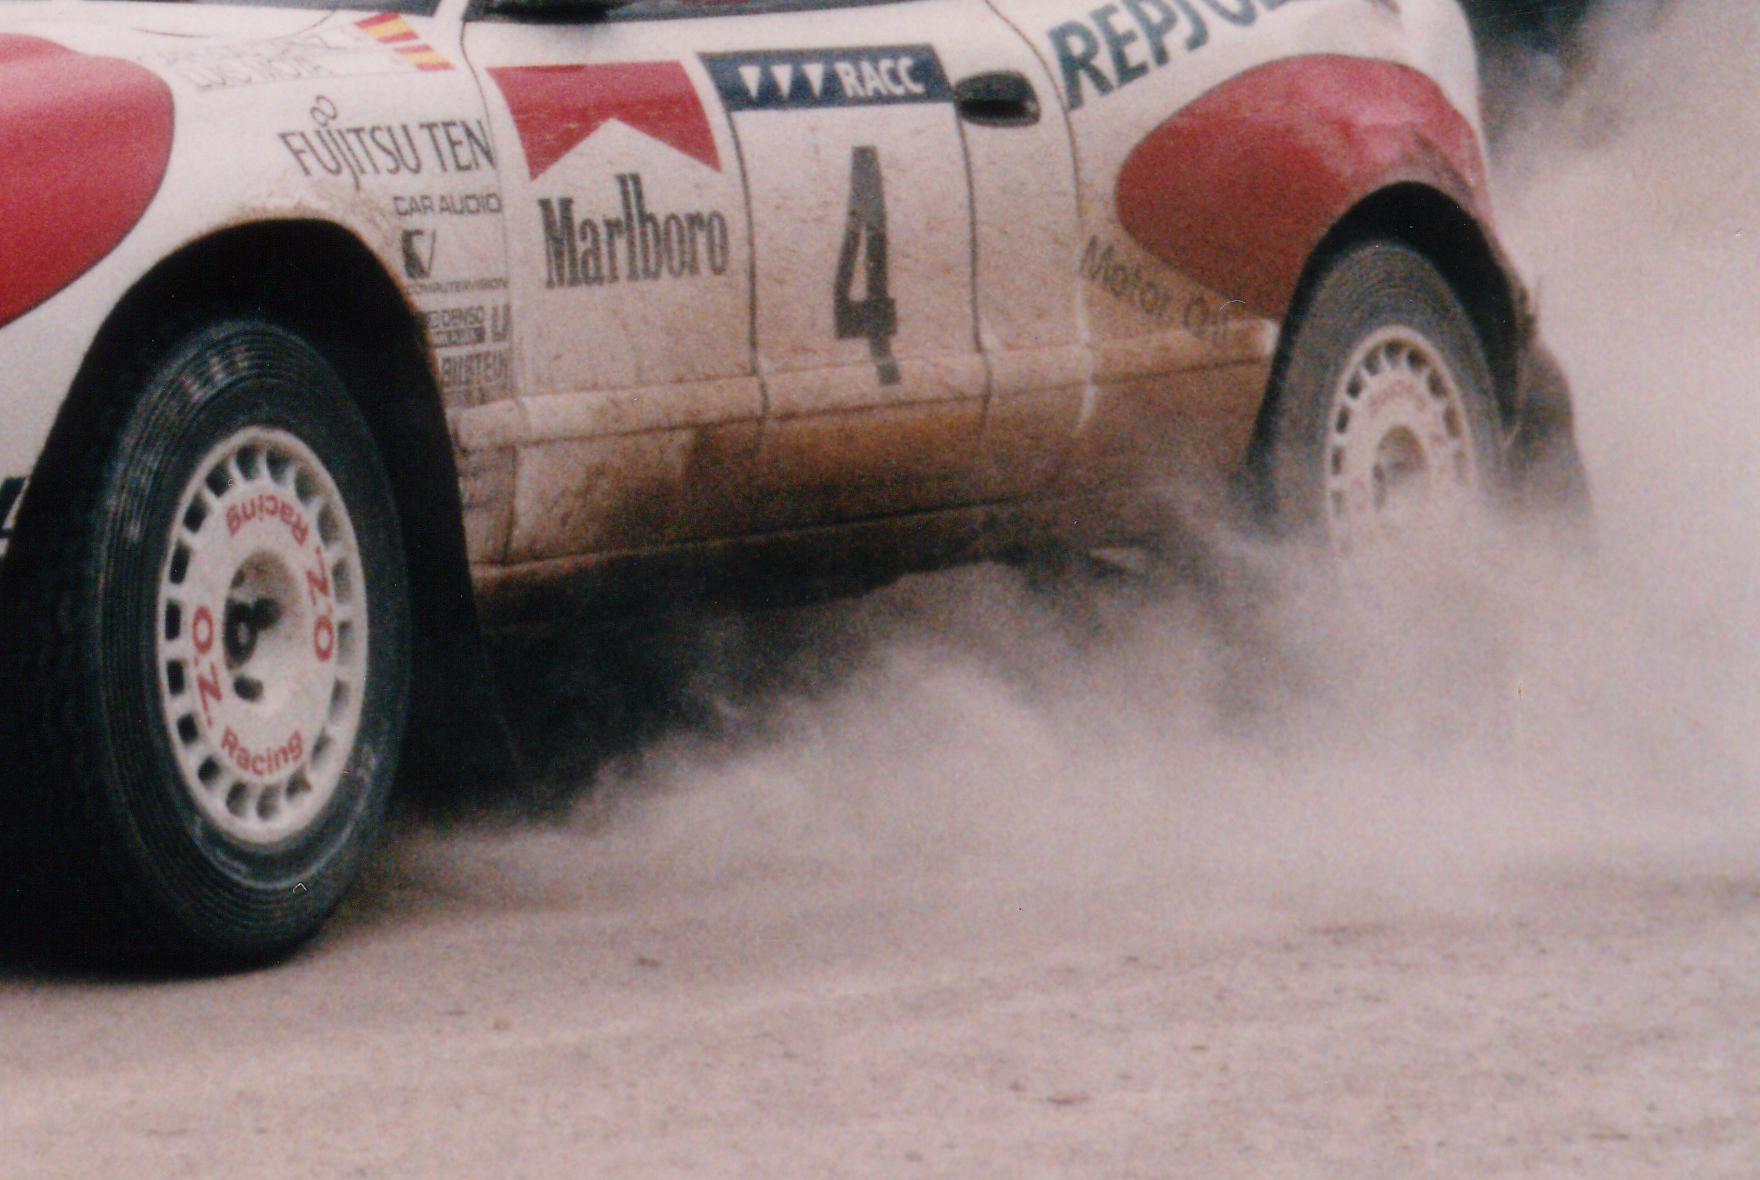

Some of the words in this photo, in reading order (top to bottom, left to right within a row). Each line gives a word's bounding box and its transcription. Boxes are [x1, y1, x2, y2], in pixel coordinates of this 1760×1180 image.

[835, 56, 927, 98] RACC
[278, 123, 422, 191] FUJITSU
[418, 120, 497, 172] TEN
[393, 195, 435, 216] CAR
[439, 192, 503, 215] AUDIO
[537, 172, 730, 289] Marlboro
[833, 145, 899, 385] 4
[225, 494, 310, 547] Racing
[220, 729, 305, 777] Racing
